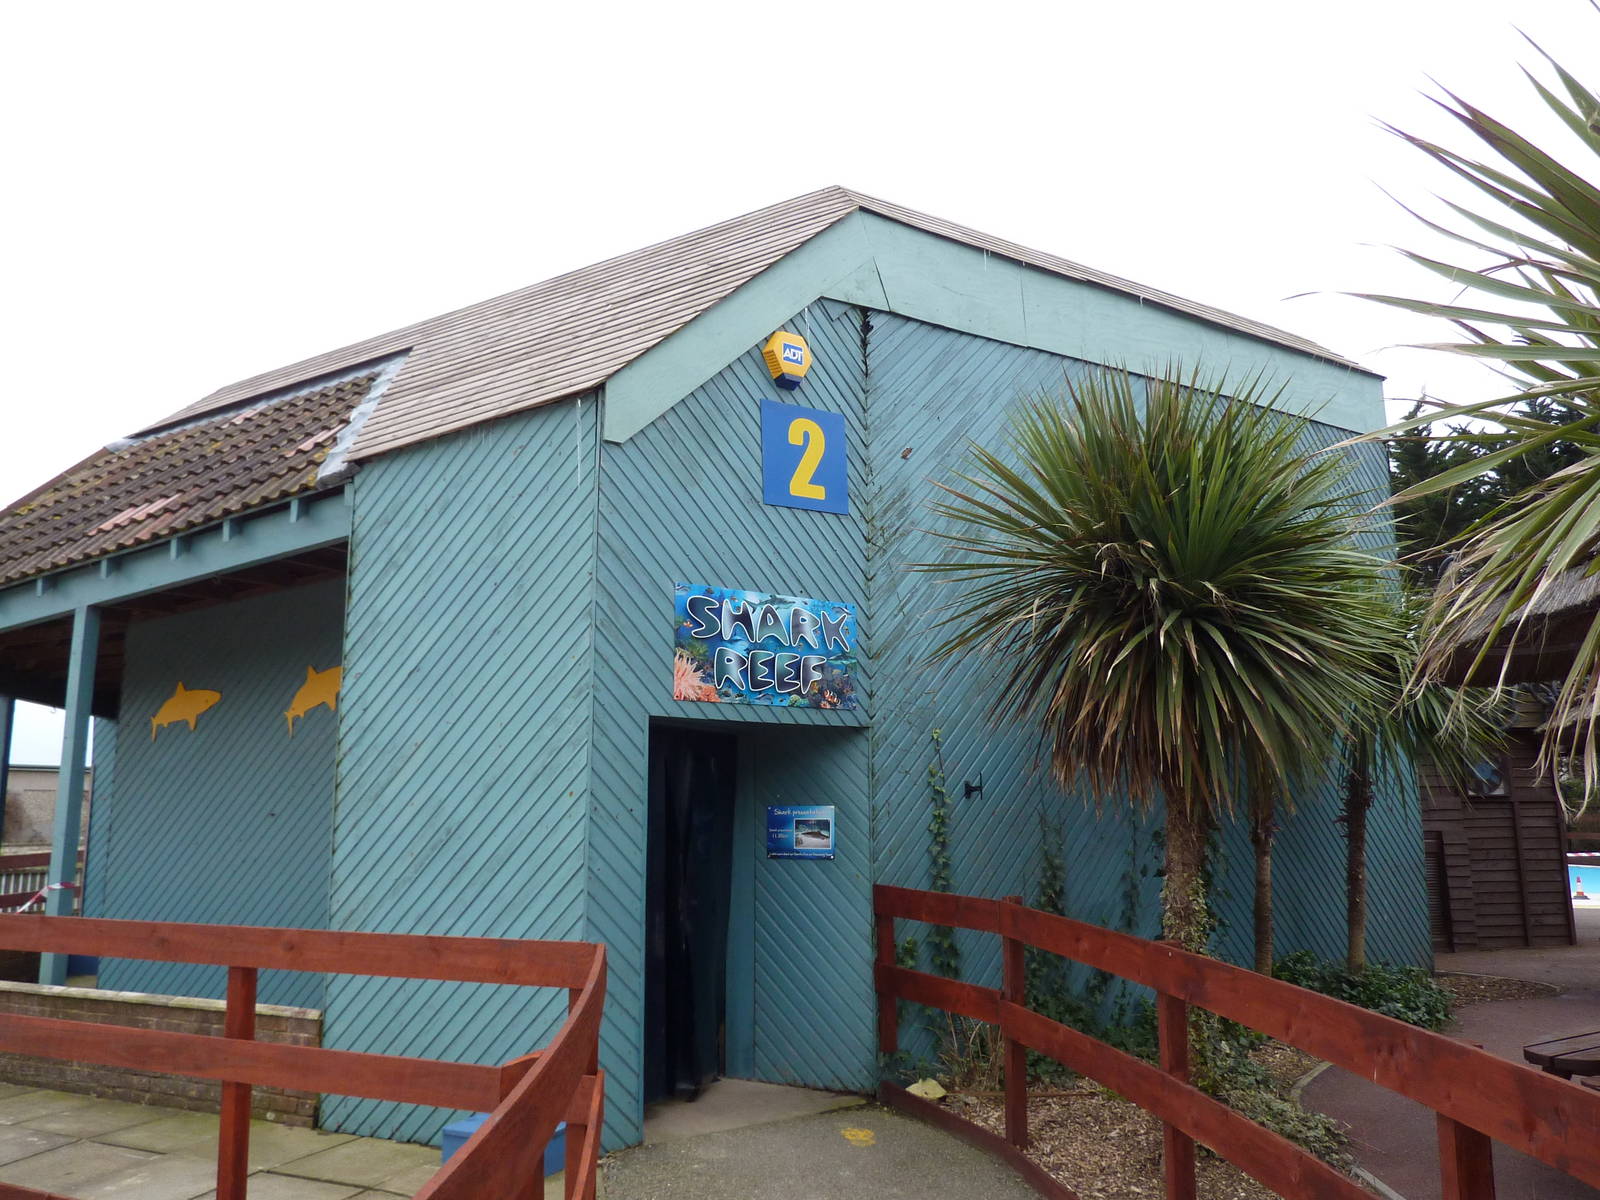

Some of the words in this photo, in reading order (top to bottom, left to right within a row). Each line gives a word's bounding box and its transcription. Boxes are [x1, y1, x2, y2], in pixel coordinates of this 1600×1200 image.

[784, 347, 803, 362] ADT
[788, 418, 826, 500] 2
[687, 595, 849, 651] SHARK
[714, 647, 827, 694] REEF
